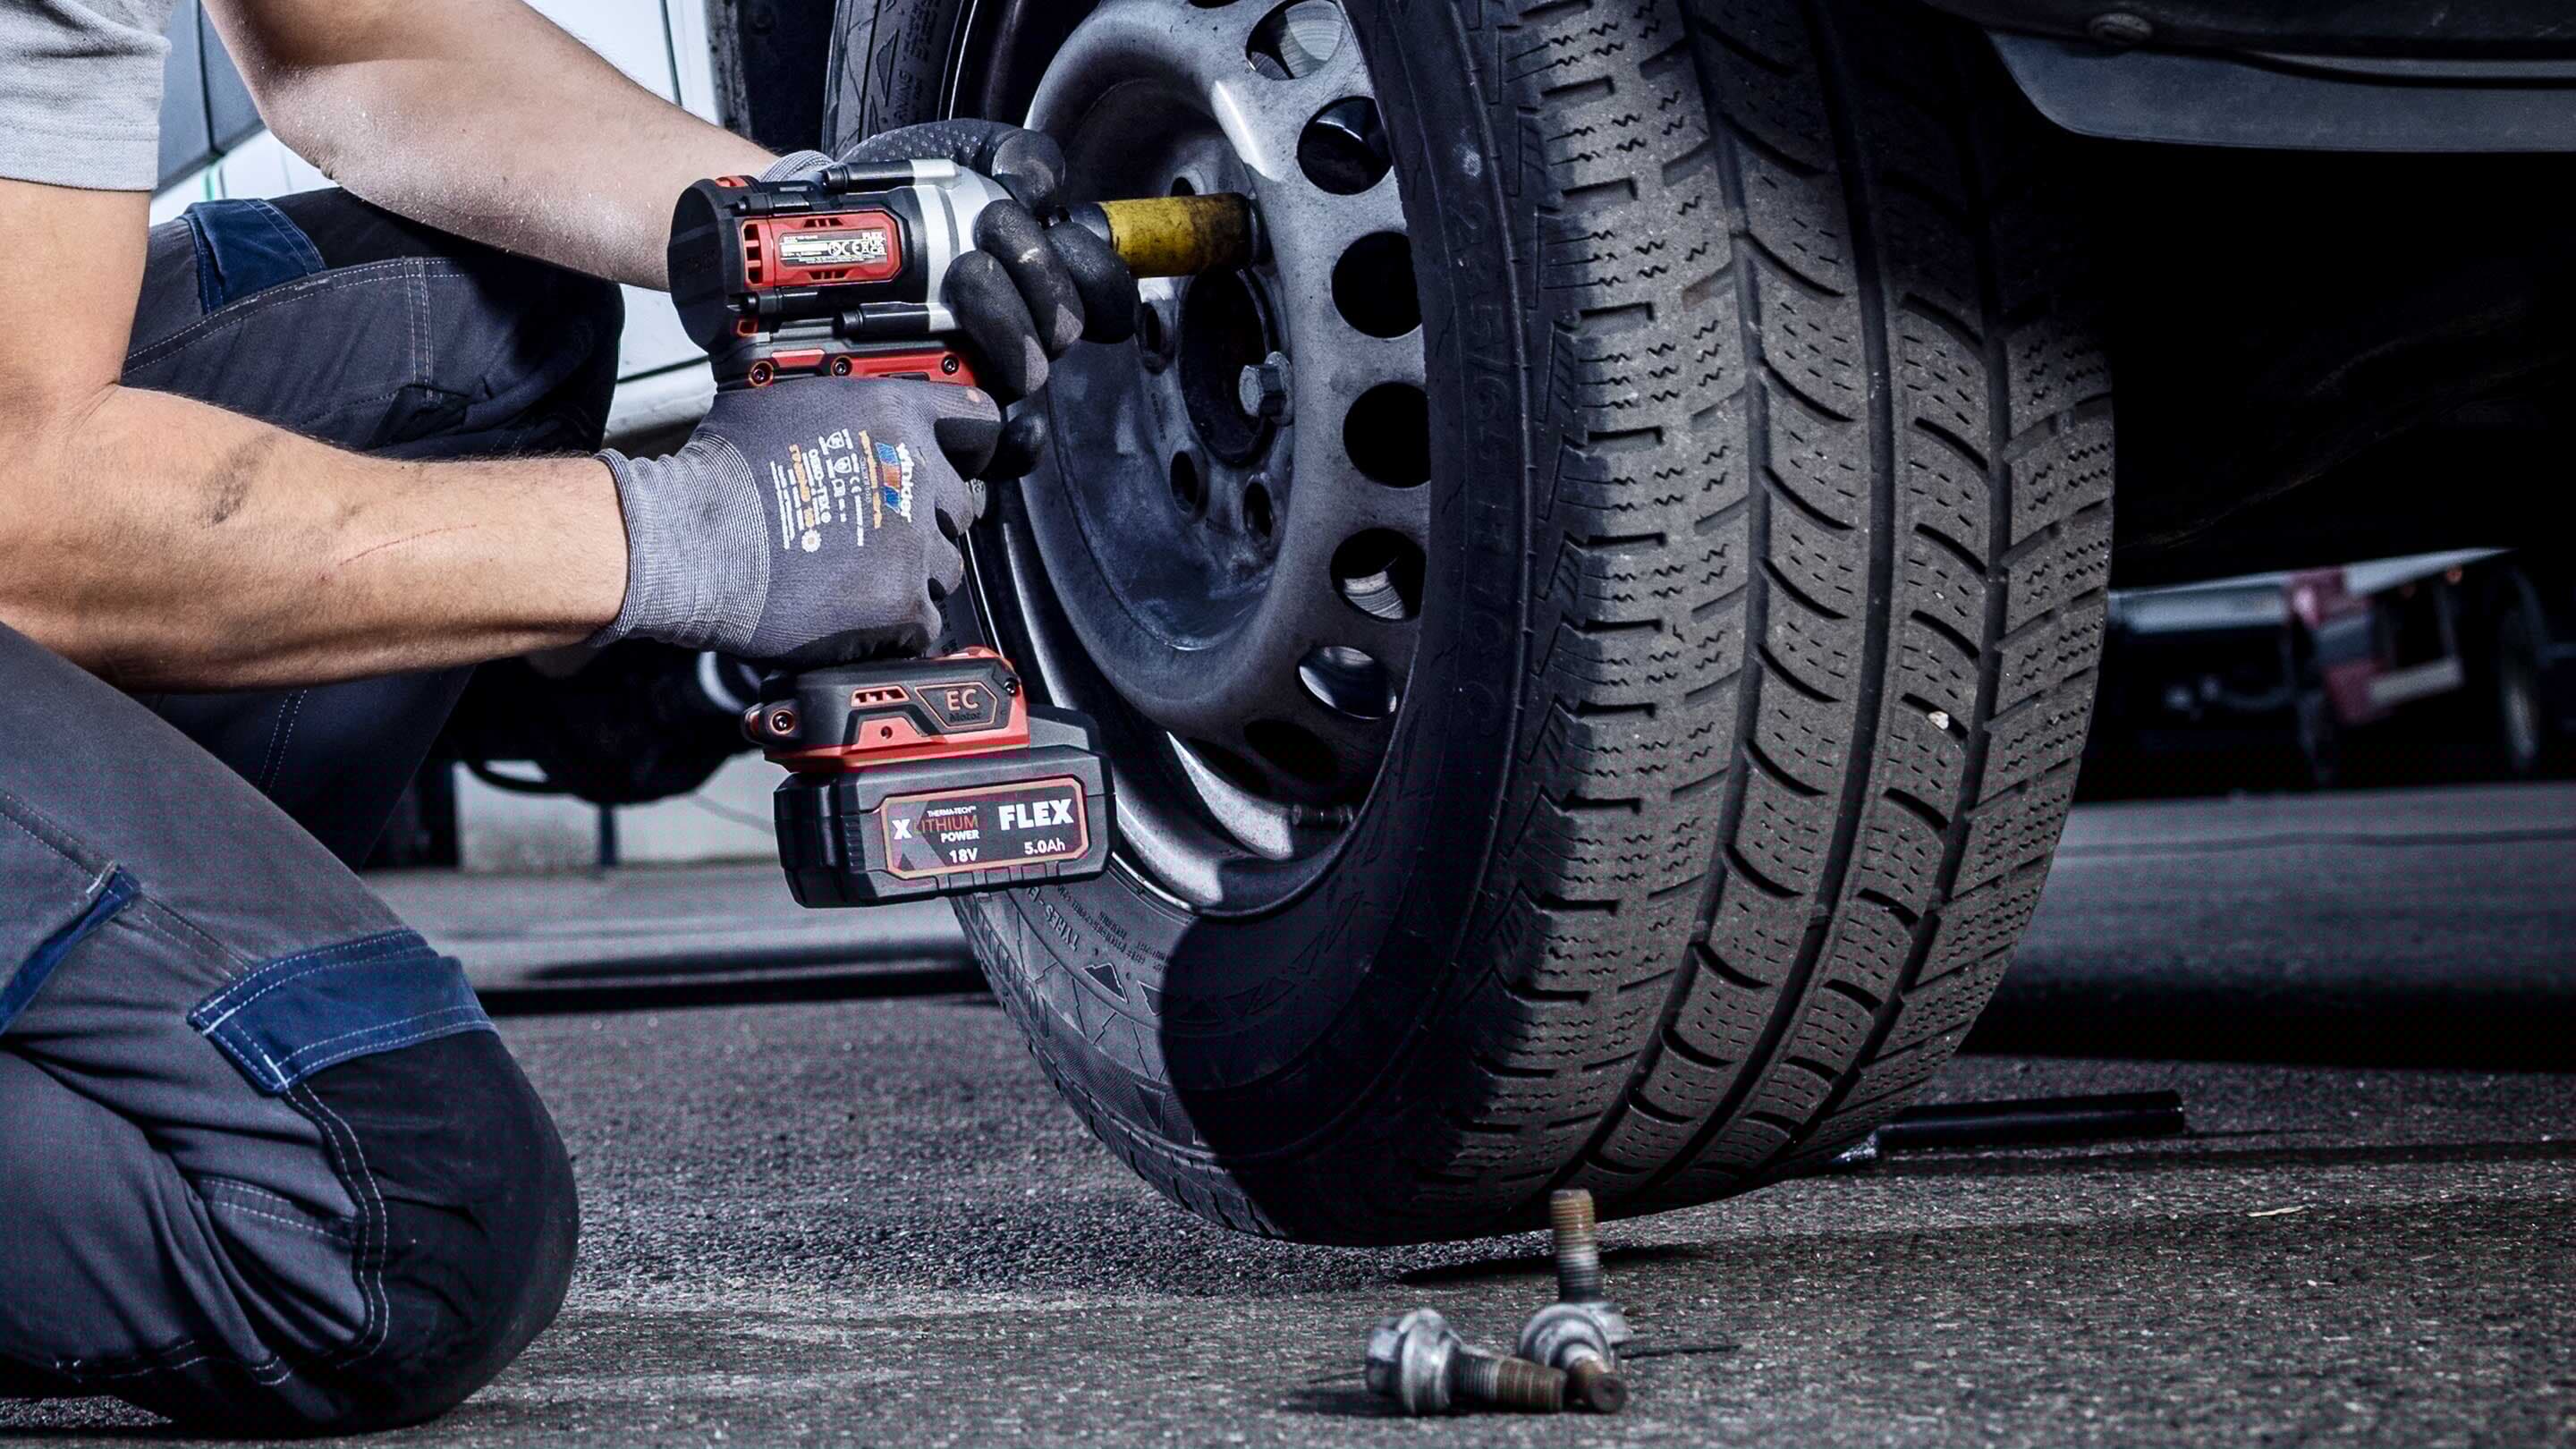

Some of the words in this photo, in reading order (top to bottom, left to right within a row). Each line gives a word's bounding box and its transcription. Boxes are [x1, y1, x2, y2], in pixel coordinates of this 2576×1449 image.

[946, 688, 979, 711] EC
[998, 799, 1074, 830] FLEX
[912, 814, 979, 835] LITHIUM
[940, 829, 980, 843] POWER
[948, 848, 978, 863] 18V
[1024, 837, 1066, 855] 5.0Ah
